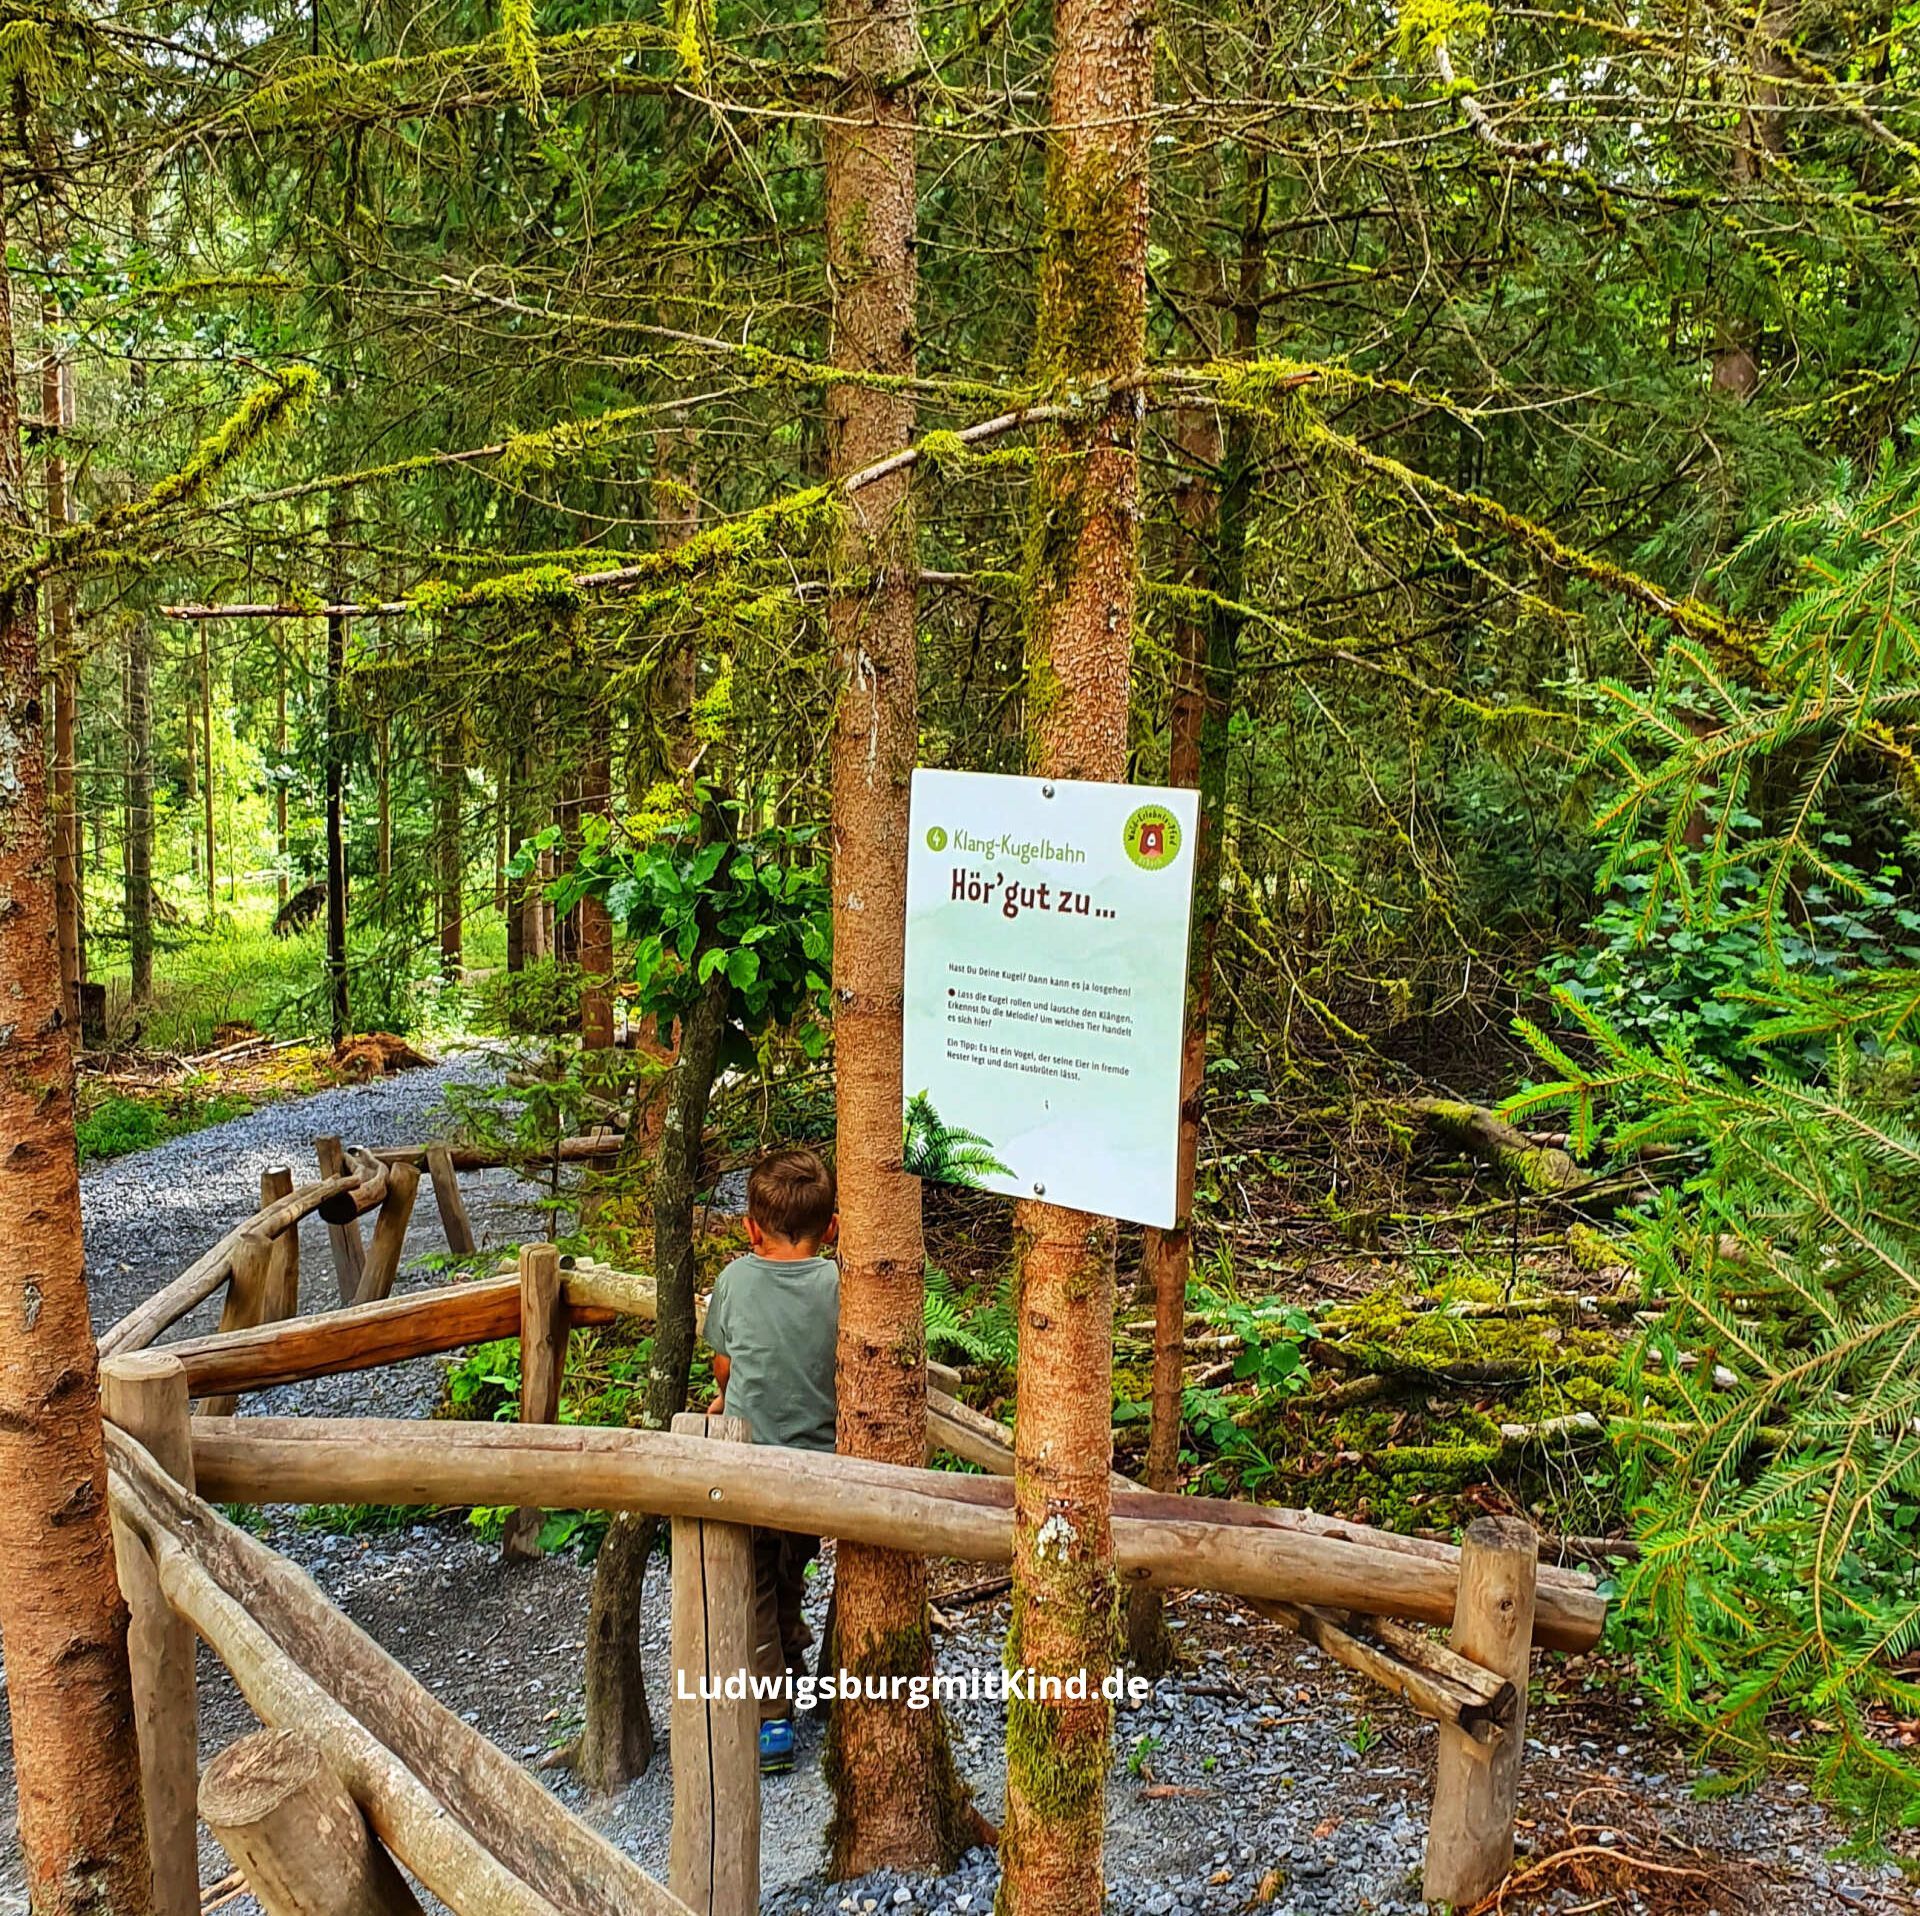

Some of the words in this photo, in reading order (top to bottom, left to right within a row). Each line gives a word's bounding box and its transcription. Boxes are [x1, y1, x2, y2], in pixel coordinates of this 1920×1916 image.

[953, 829, 1086, 864] Klang-Kugelbahn
[949, 963, 965, 973] Hast
[967, 965, 977, 975] Du
[979, 967, 1000, 979] Deine
[1028, 974, 1048, 984] Dann
[1050, 977, 1070, 988] kann
[1082, 981, 1090, 992] ja
[948, 1000, 979, 1013] Erkennst
[981, 1005, 991, 1014] Du
[992, 1007, 1004, 1017] die
[1040, 1014, 1053, 1024] Um
[1054, 1016, 1085, 1029] welches
[1087, 1022, 1100, 1032] Tier
[958, 989, 973, 999] Lass
[975, 991, 986, 1001] die
[988, 994, 1008, 1006] Kugel
[1010, 997, 1031, 1008] rollen
[1033, 1001, 1048, 1011] und
[1050, 1002, 1080, 1016] lausche
[1082, 1008, 1097, 1018] den
[958, 1014, 972, 1024] sich
[947, 1038, 958, 1047] Ein
[980, 1043, 987, 1052] Es
[989, 1044, 999, 1054] ist
[1000, 1047, 1012, 1056] ein
[1038, 1052, 1051, 1062] der
[1053, 1055, 1073, 1066] seine
[1075, 1058, 1090, 1069] Eier
[1092, 1061, 1100, 1070] in
[1102, 1062, 1130, 1077] fremde
[947, 1050, 970, 1062] Nester
[972, 1054, 985, 1066] legt
[987, 1056, 1002, 1067] und
[1003, 1059, 1019, 1070] dort
